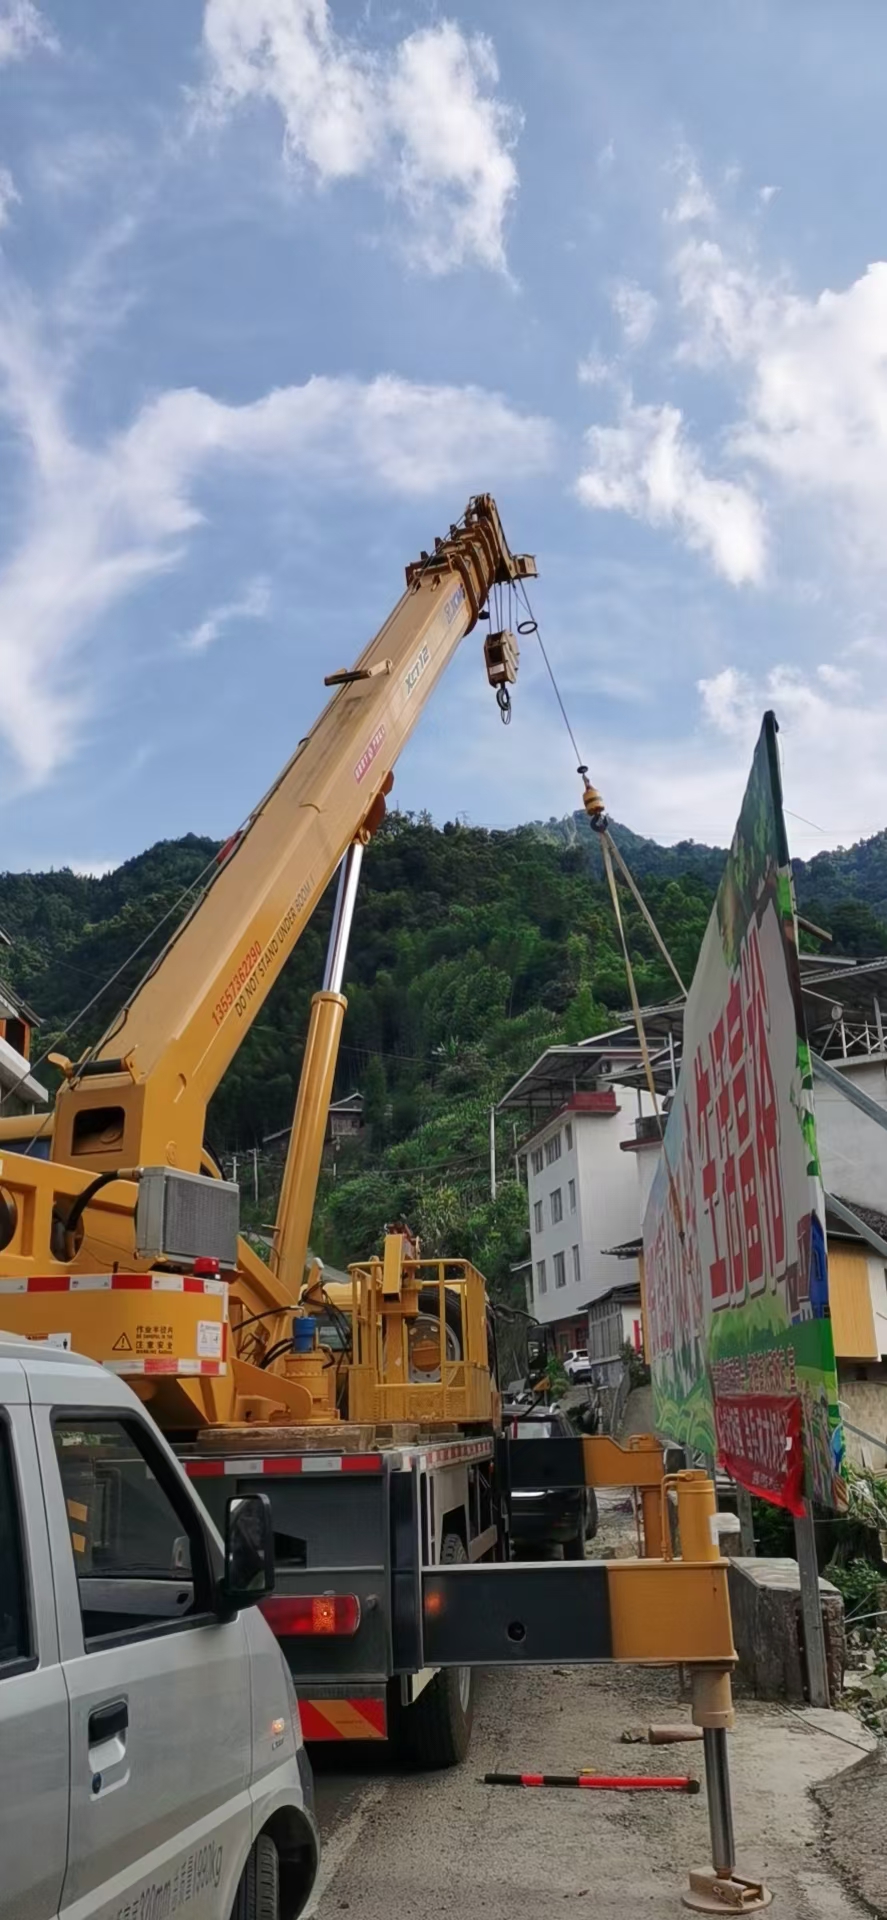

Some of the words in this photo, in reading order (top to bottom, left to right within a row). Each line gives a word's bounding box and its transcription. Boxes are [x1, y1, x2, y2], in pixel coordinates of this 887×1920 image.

[211, 940, 262, 1027] 13557362290
[235, 998, 247, 1018] DO
[244, 972, 259, 998] NOT
[258, 940, 279, 978] STAND
[277, 907, 297, 942] UNDER
